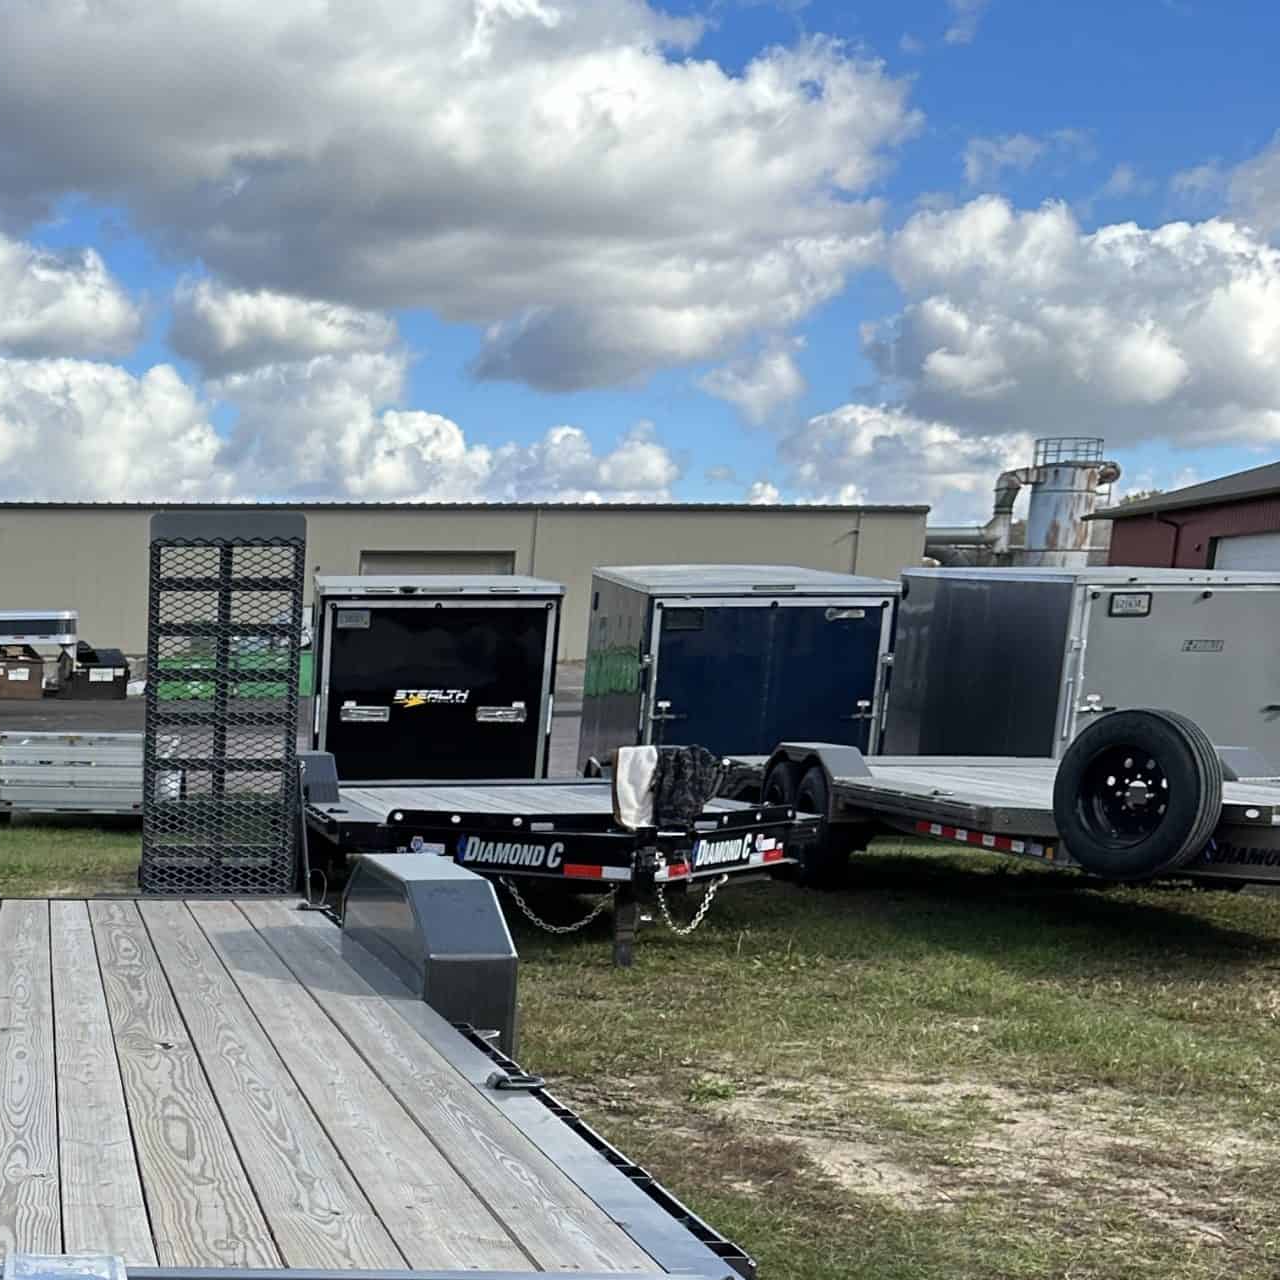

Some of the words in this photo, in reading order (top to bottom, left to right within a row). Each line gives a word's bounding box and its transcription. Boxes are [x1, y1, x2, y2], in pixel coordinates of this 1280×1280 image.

[393, 689, 470, 700] STEALTH
[463, 836, 546, 866] DIAMOND
[546, 842, 565, 868] C
[696, 839, 742, 866] DIAMOND
[742, 833, 753, 859] C
